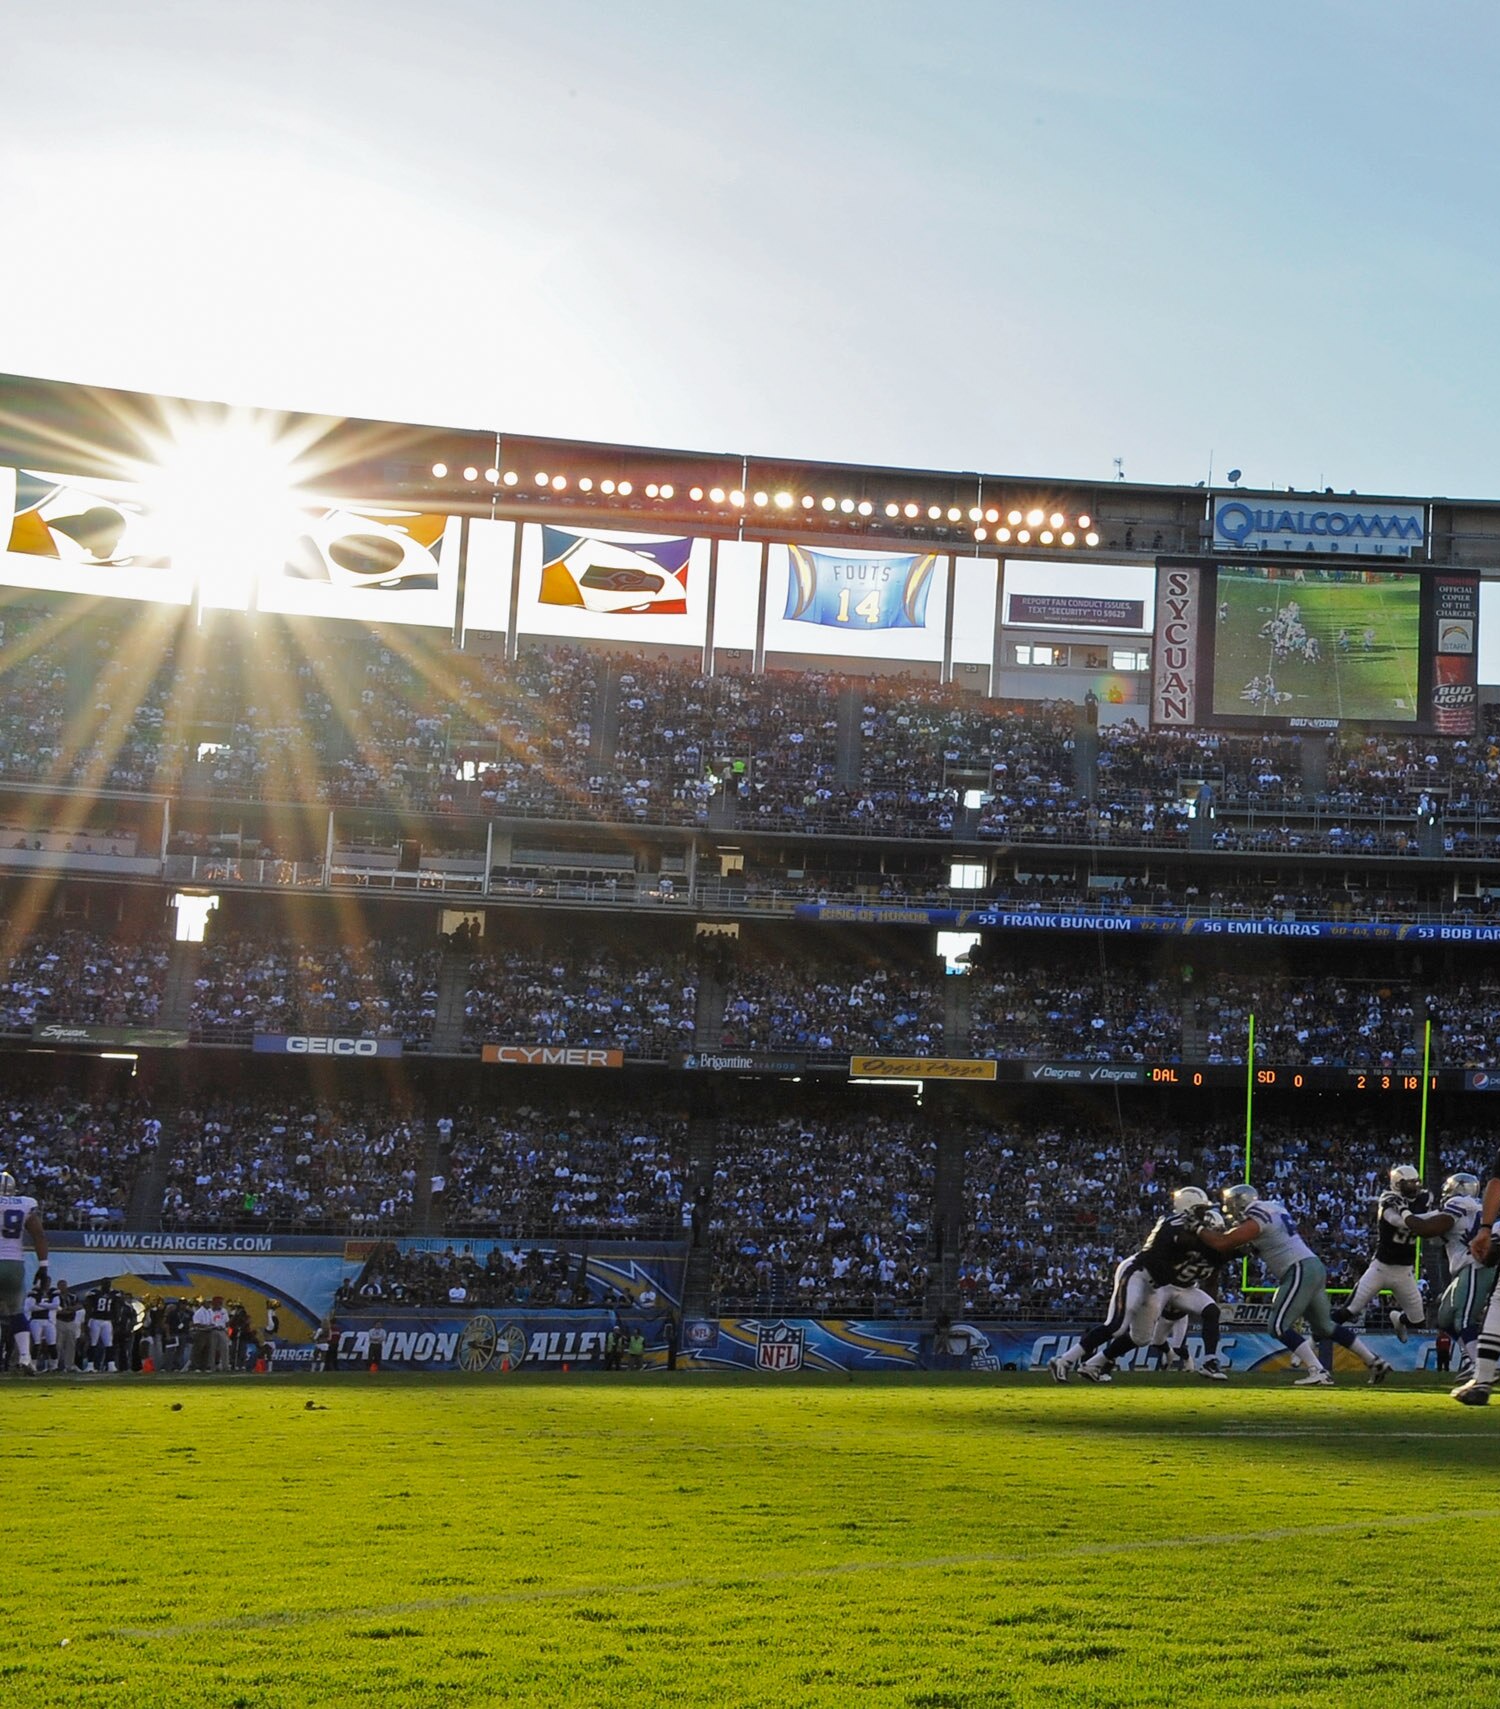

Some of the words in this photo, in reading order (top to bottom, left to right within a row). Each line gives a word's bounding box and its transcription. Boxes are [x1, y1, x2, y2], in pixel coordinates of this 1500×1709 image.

[1216, 503, 1423, 547] QUALCOMM
[1260, 539, 1409, 556] STADIUM
[833, 565, 892, 582] FOUTS
[1439, 586, 1473, 594] OFFICIAL
[836, 587, 881, 623] 14
[1022, 597, 1051, 606] REPORT
[1052, 598, 1067, 607] FAN
[1068, 599, 1103, 609] CONDUCT
[1028, 606, 1046, 614] TEXT
[1436, 610, 1477, 618] CHARGERS
[1162, 573, 1190, 719] SYCUAN
[1438, 686, 1472, 695] BUD
[1434, 694, 1476, 704] LIGHT
[979, 914, 997, 925] 55
[1003, 914, 1057, 928] FRANK
[1061, 916, 1131, 930] BUNCOM
[1204, 921, 1222, 932] 56
[1228, 921, 1264, 934] EMIL
[1268, 922, 1320, 935] KARAS
[1418, 928, 1435, 938] 53
[1441, 928, 1472, 940] BOB
[40, 1024, 90, 1039] Sycuan
[286, 1036, 378, 1056] GEICO
[497, 1046, 608, 1066] CYMER
[700, 1053, 753, 1070] Brigantine
[926, 1061, 986, 1077] Pizza
[1044, 1067, 1081, 1079] Degree
[1100, 1067, 1137, 1080] Degree
[1153, 1068, 1179, 1082] DAL
[1193, 1073, 1202, 1085] 0
[1258, 1070, 1276, 1083] SD
[1294, 1075, 1303, 1087] 0
[1357, 1076, 1366, 1089] 2
[1381, 1076, 1390, 1089] 3
[1404, 1077, 1418, 1090] 18
[1432, 1077, 1437, 1090] 1
[84, 1233, 272, 1251] WWW.CHARGERS.COM
[97, 1297, 112, 1311] 81
[761, 1345, 797, 1368] NFL
